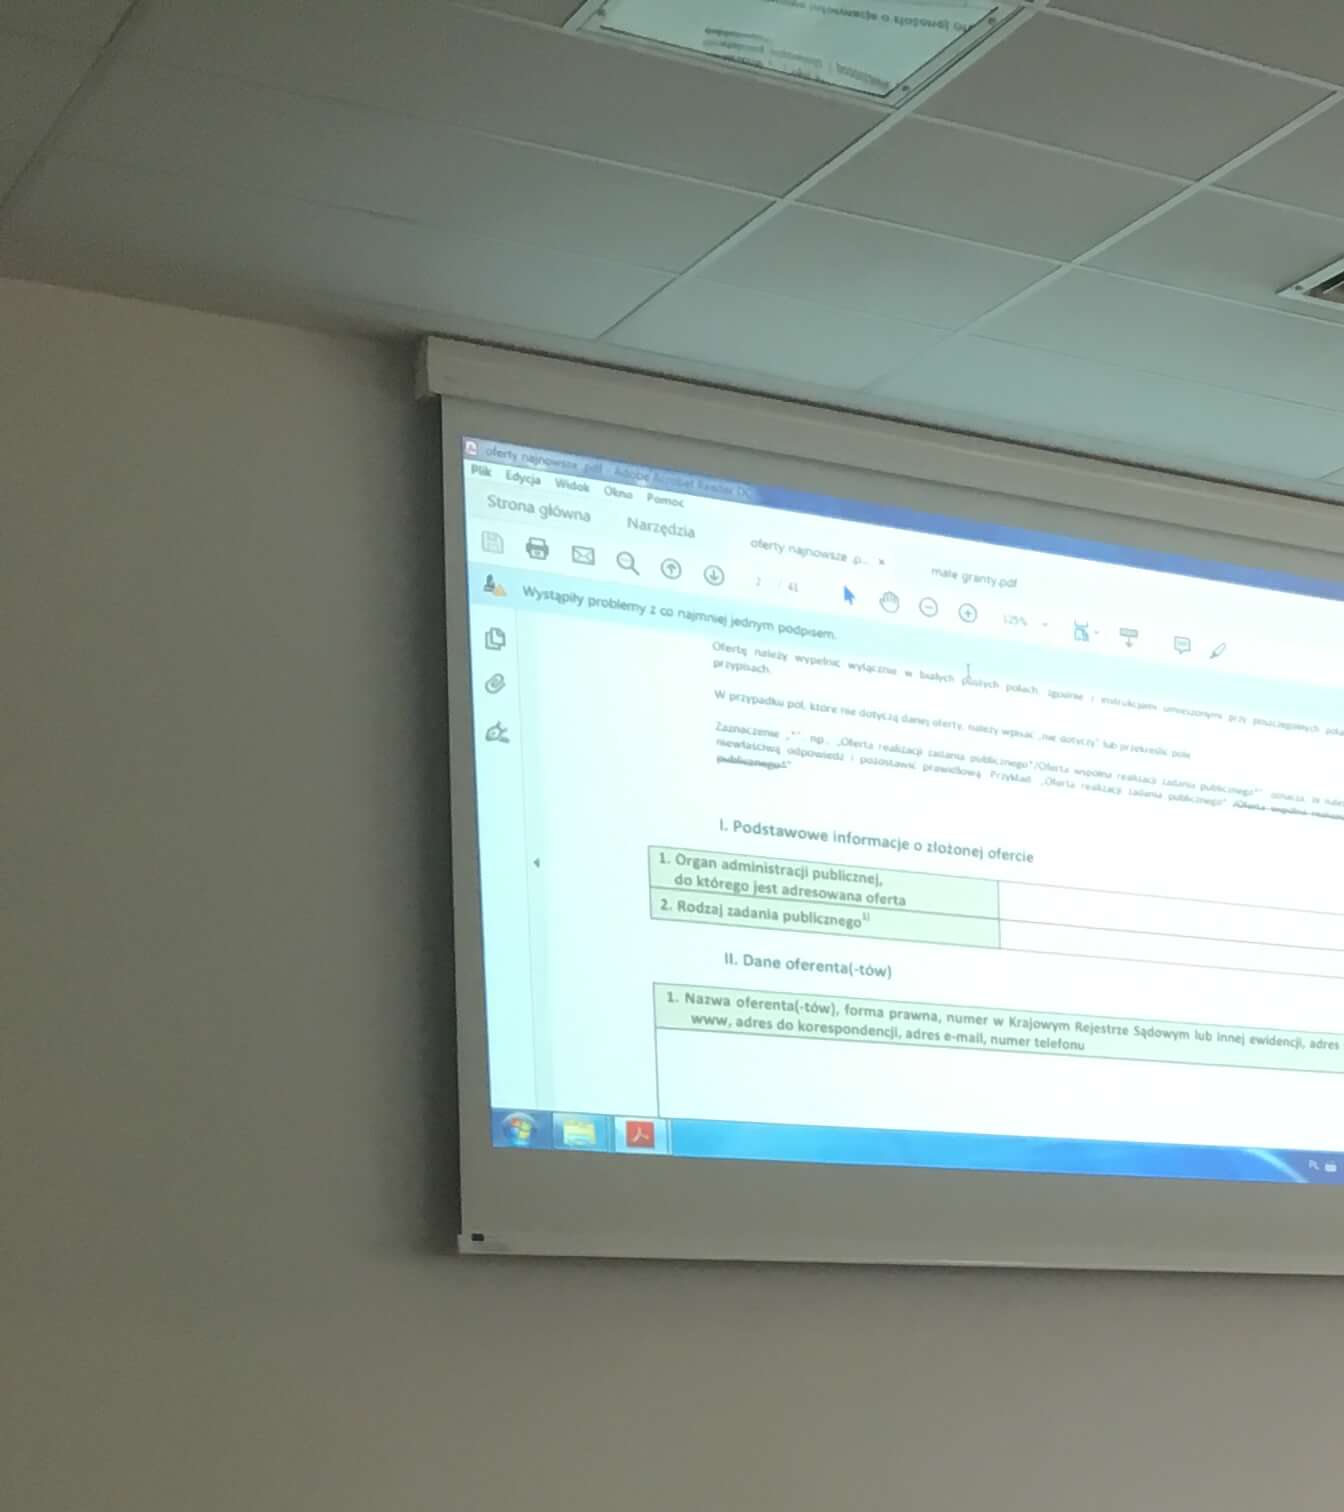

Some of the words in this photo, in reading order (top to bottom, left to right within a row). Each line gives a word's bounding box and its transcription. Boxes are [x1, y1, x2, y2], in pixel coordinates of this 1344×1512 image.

[505, 469, 542, 487] Edycja
[554, 477, 590, 493] Widok
[603, 485, 633, 500] Okno
[646, 491, 685, 508] Pomoc
[486, 493, 536, 514] Strona
[538, 502, 591, 523] główna
[626, 515, 696, 539] Narzędzia
[749, 537, 785, 554] oferty
[521, 584, 585, 607] Wystąpiły
[586, 596, 647, 616] problemy
[658, 607, 674, 617] co
[676, 609, 728, 627] najmniej
[729, 617, 775, 633] jednym
[777, 623, 835, 640] podpisem.
[719, 817, 729, 832] I.
[732, 819, 829, 842] Podstawowe
[832, 830, 910, 852] informacje
[913, 841, 923, 852] o
[926, 840, 984, 860] złożonej
[987, 847, 1034, 863] ofercie
[659, 851, 671, 865] 1.
[674, 851, 717, 871] Organ
[720, 858, 809, 881] administracji
[811, 867, 883, 888] publicznej,
[673, 872, 693, 886] do
[695, 874, 750, 894] którego
[752, 879, 778, 895] jest
[781, 883, 862, 903] adresowana
[864, 891, 906, 907] oferta
[659, 897, 672, 911] 2.
[676, 899, 723, 919] Rodzaj
[726, 905, 779, 921] zadania
[724, 951, 738, 965] II.
[742, 953, 781, 969] Dane
[784, 957, 892, 980] oferenta(-tów)
[666, 990, 679, 1003] 1.
[684, 991, 731, 1007] Nazwa
[735, 995, 840, 1017] oferenta(-tów),
[843, 1002, 884, 1018] forma
[888, 1009, 942, 1024] prawna,
[945, 1013, 989, 1026] numer
[992, 1017, 1003, 1027] w
[1008, 1015, 1071, 1033] Krajowym
[1074, 1020, 1129, 1036] Rejestrze
[1133, 1024, 1190, 1041] Sądowym
[1193, 1028, 1213, 1042] lub
[1216, 1031, 1245, 1047] innej
[1248, 1034, 1306, 1050] ewidencji,
[1309, 1038, 1340, 1051] adres
[690, 1014, 732, 1028] www,
[734, 1015, 773, 1030] adres
[775, 1017, 794, 1031] do
[796, 1018, 902, 1040] korespondencji,
[905, 1027, 941, 1041] adres
[943, 1031, 987, 1046] e-mail,
[989, 1035, 1031, 1047] numer
[1033, 1036, 1085, 1051] telefonu
